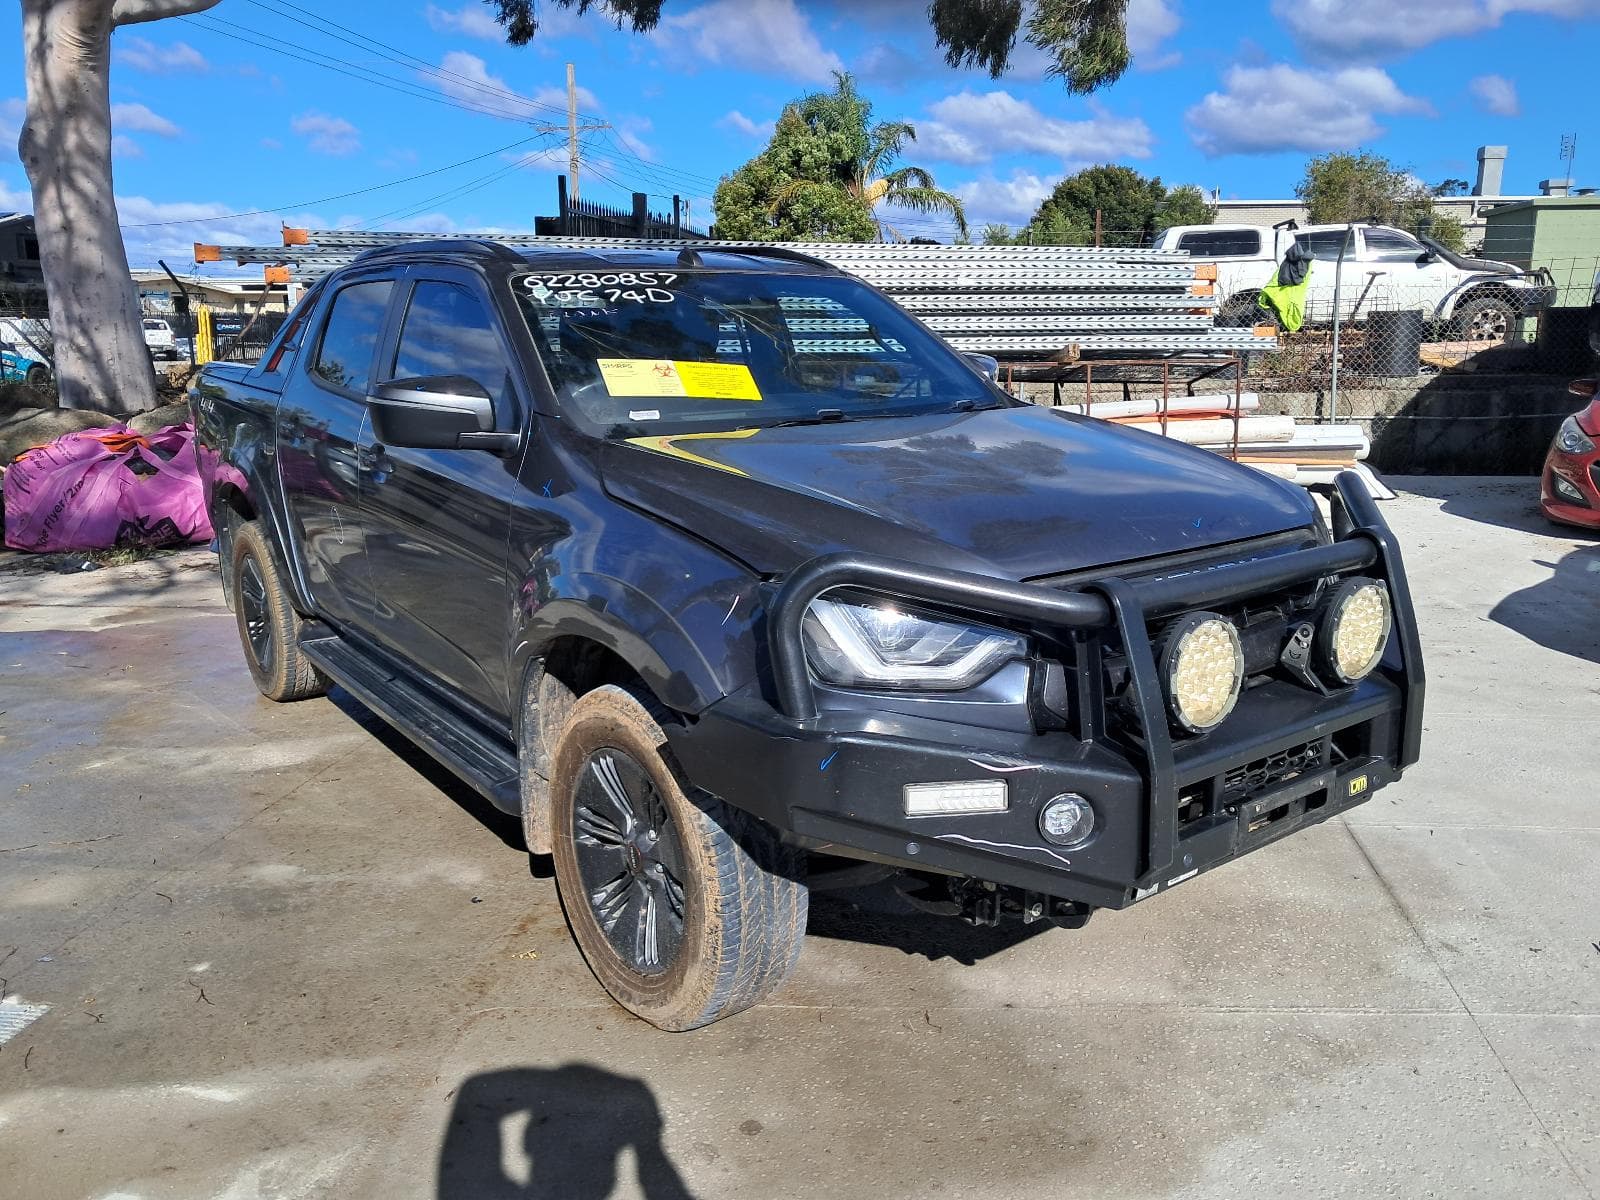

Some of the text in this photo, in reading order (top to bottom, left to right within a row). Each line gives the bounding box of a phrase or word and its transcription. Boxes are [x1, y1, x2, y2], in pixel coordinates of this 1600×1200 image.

[523, 273, 678, 288] 62280857
[527, 288, 675, 305] YJC 74D
